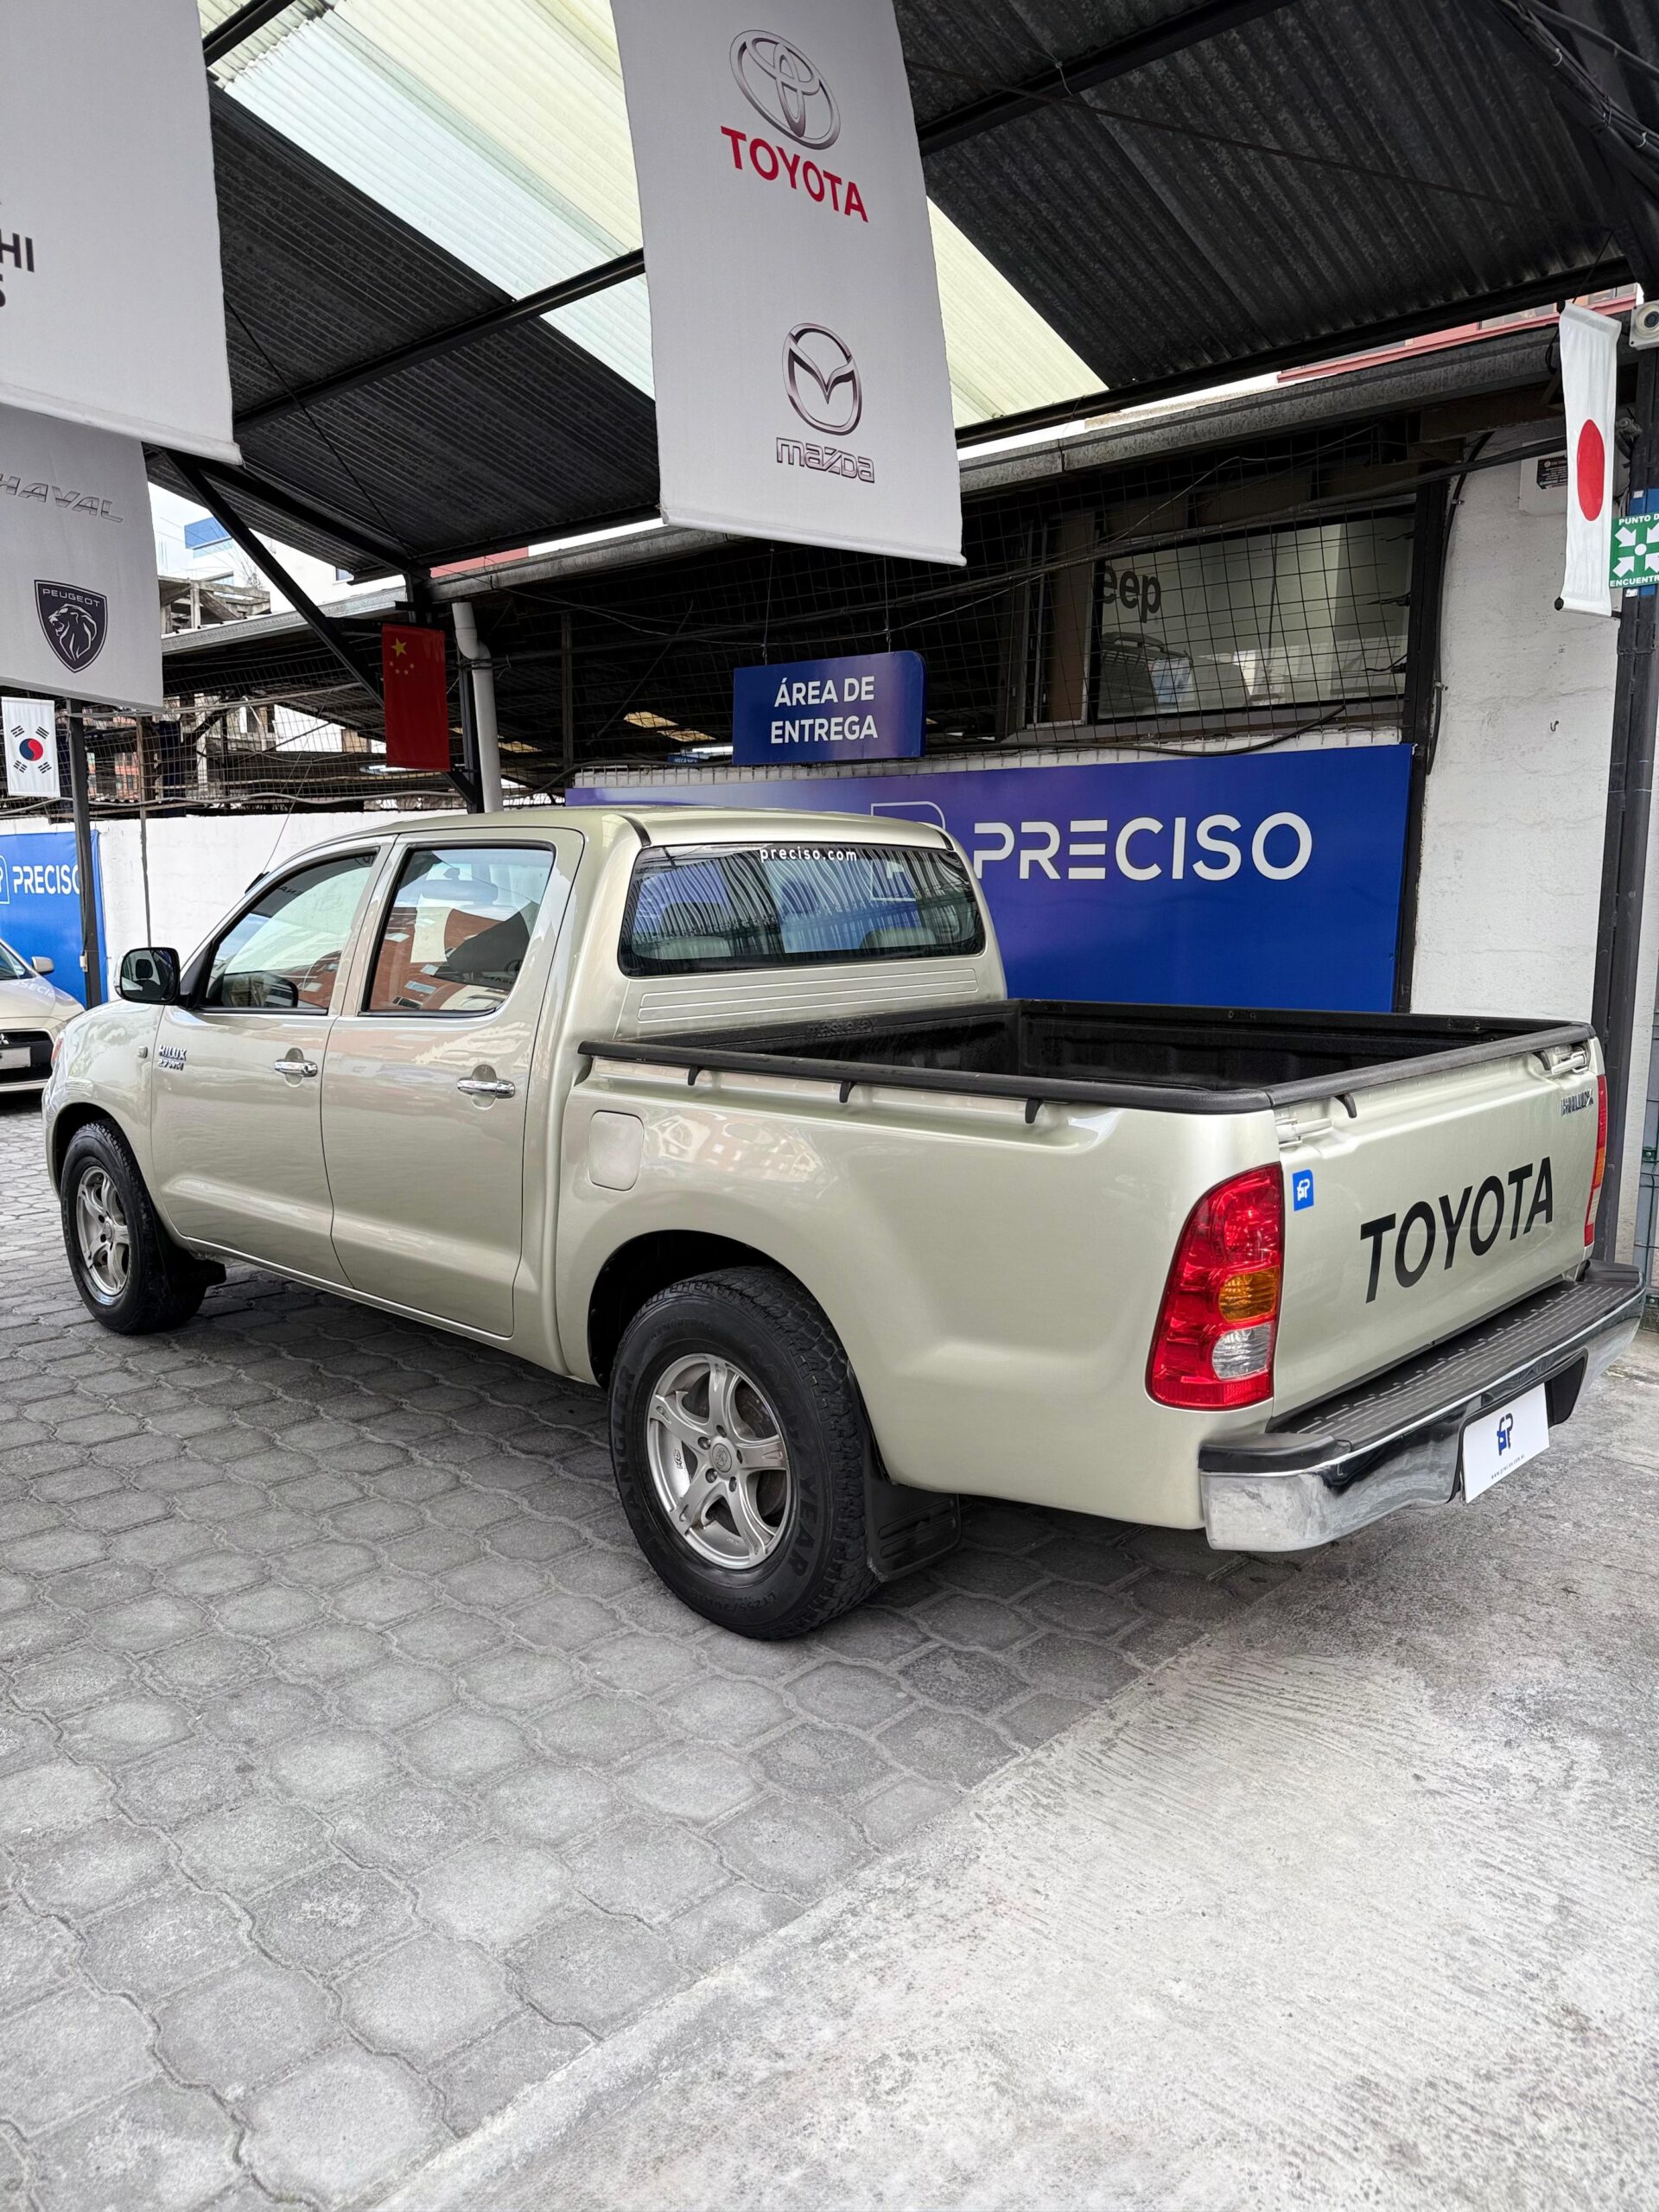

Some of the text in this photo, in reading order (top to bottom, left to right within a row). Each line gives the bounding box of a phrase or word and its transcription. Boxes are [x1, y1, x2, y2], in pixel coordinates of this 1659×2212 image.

[721, 126, 869, 223] TOYOTA
[776, 436, 875, 484] mazda
[0, 474, 124, 524] HAVAL
[1618, 514, 1651, 525] PUNTO
[42, 588, 101, 607] PEUGEOT
[774, 676, 875, 708] ÁREA DE
[770, 715, 879, 745] ENTREGA
[760, 846, 857, 862] preciso.com
[973, 811, 1313, 880] PRECISO
[159, 1045, 188, 1061] HILUX
[1360, 1156, 1554, 1304] TOYOTA
[748, 1344, 818, 1578] GOODYEAR
